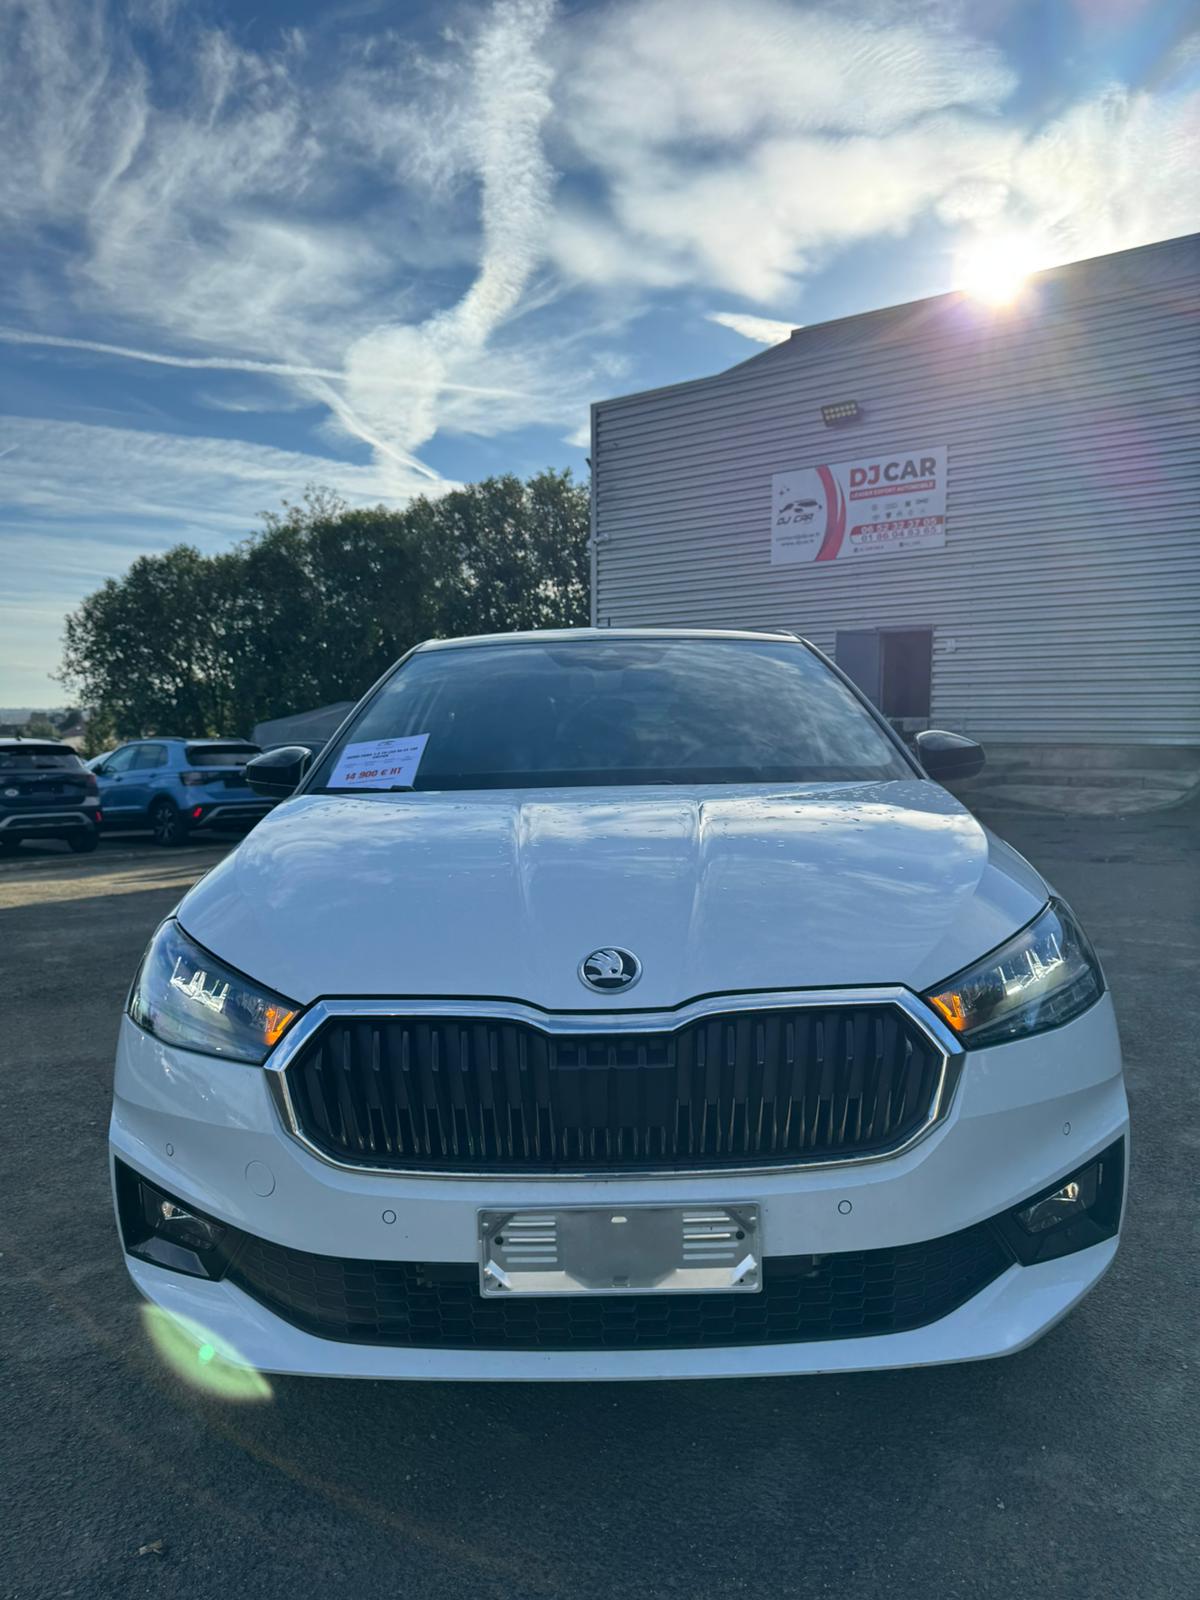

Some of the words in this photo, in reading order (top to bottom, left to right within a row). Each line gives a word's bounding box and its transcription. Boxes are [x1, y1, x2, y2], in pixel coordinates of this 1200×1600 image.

[850, 464, 880, 487] DJ
[883, 457, 937, 481] CAR
[345, 772, 356, 780] 14
[359, 770, 378, 778] 900
